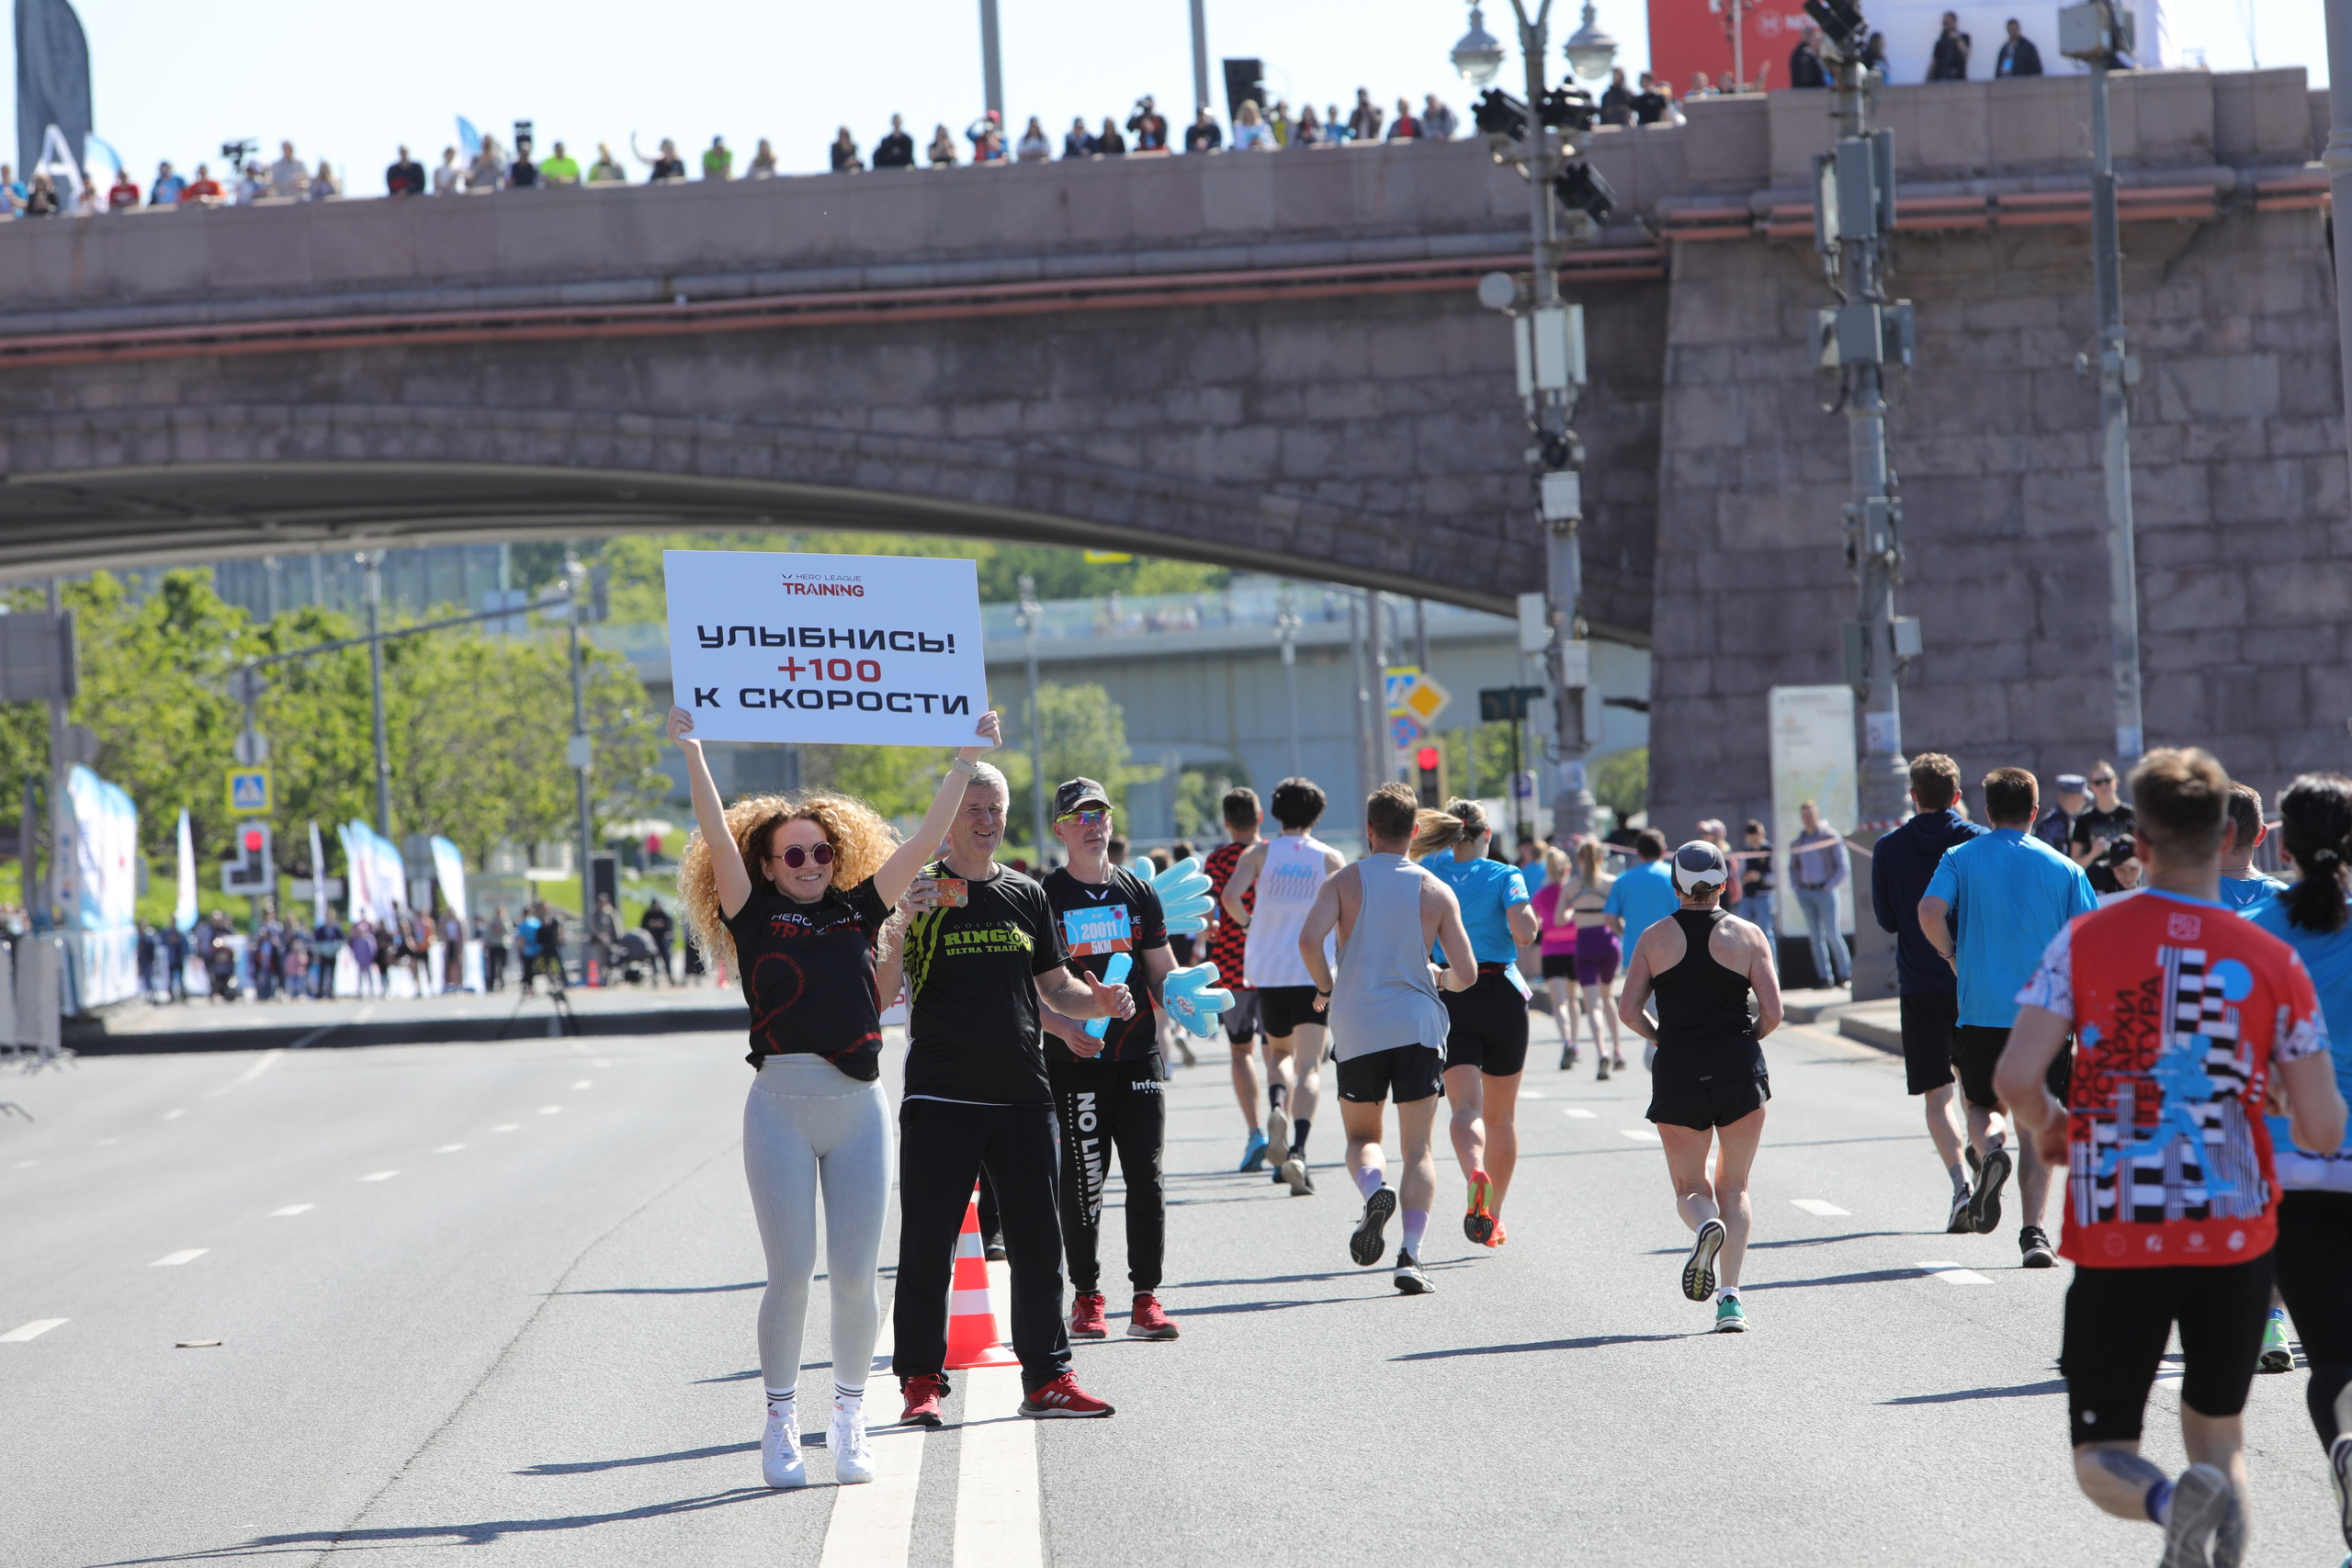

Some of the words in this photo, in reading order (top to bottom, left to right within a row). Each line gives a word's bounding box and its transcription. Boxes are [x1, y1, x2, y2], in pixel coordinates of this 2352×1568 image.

[824, 574, 862, 582] LEAGUE
[782, 582, 865, 598] TRAINING
[696, 625, 956, 654] УЛЫБНИСЬ!
[777, 656, 882, 682] +100
[694, 687, 722, 708] К
[739, 687, 970, 716] СКОРОСТИ
[943, 929, 1008, 946] RING
[1080, 920, 1118, 941] 20011
[945, 946, 983, 956] ULTRA
[985, 944, 1020, 953] TRAIL
[1077, 1092, 1097, 1132] NO
